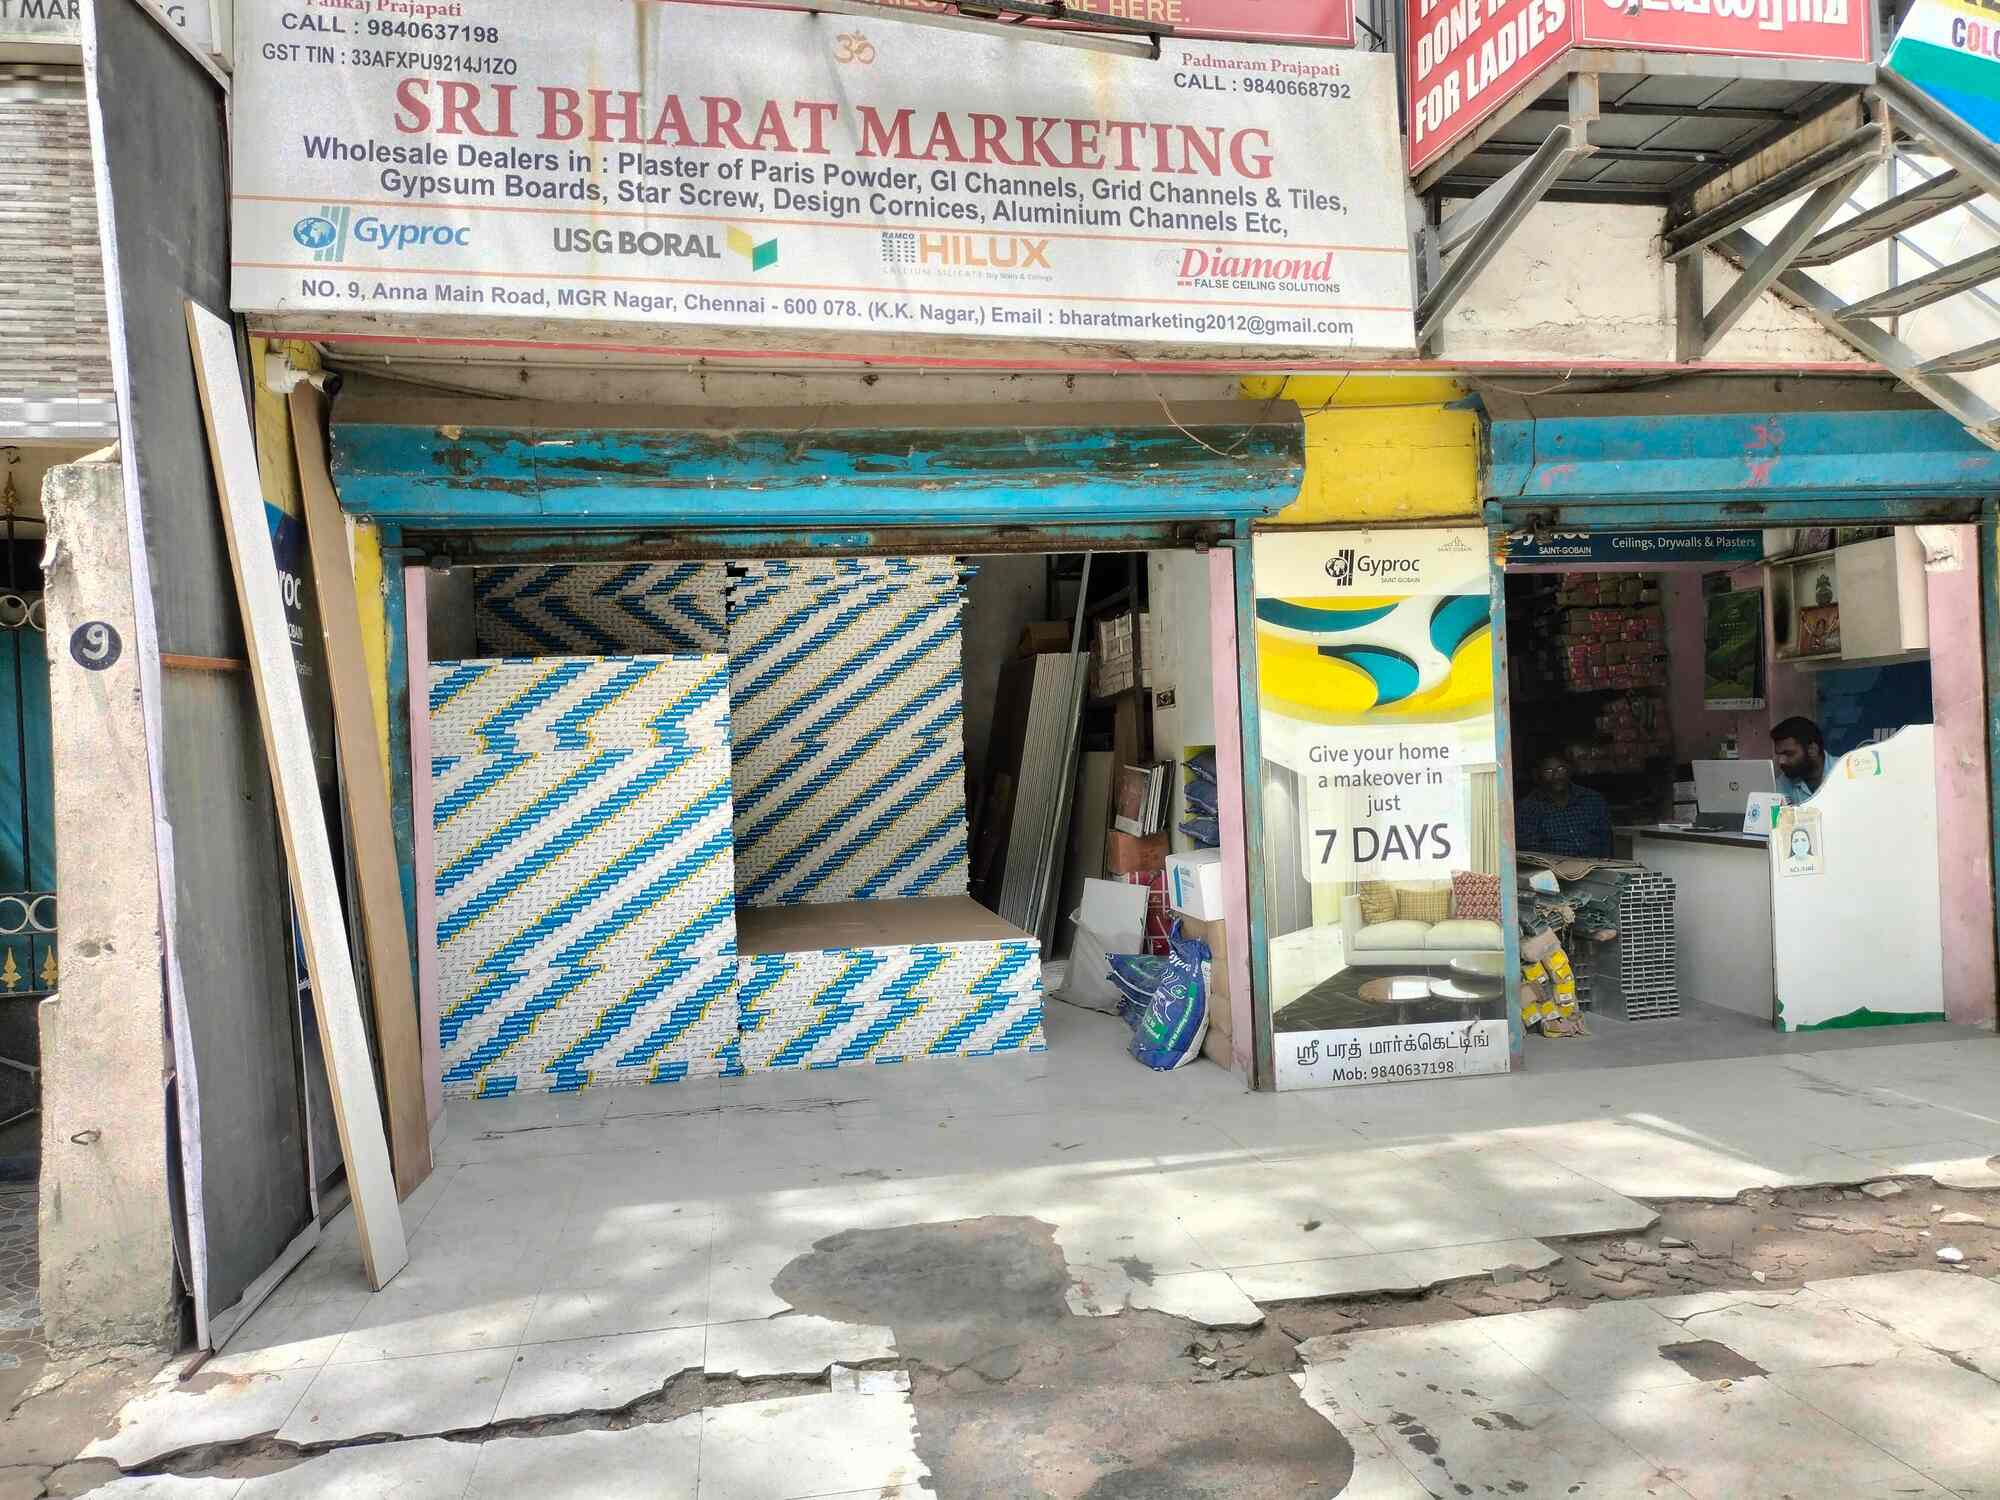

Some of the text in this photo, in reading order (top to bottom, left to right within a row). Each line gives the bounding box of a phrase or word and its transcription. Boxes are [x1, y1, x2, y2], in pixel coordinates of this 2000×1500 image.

[20, 0, 80, 19] MAR
[376, 0, 462, 18] Prajapati
[282, 13, 346, 33] CALL
[367, 19, 499, 43] 9840637198
[1417, 0, 1482, 81] DONE
[263, 43, 300, 62] GST
[305, 46, 334, 64] TIN
[1182, 53, 1341, 78] Padmaram Prajapati
[1174, 72, 1226, 91] CALL
[1243, 77, 1351, 98] 9840668792
[1416, 0, 1566, 144] FOR LADIES
[394, 78, 1275, 180] SRI BHARAT MARKETING
[303, 135, 448, 166] Wholesale
[458, 144, 559, 171] Dealers
[569, 150, 591, 173] in
[618, 152, 709, 178] Plaster
[718, 158, 743, 180] of
[751, 159, 814, 184] Paris
[824, 164, 922, 194] Powder,
[930, 169, 956, 192] GI
[964, 171, 1085, 202] Channels,
[1092, 177, 1141, 201] Grid
[1150, 180, 1257, 207] Channels
[1265, 187, 1281, 207] &
[1287, 188, 1348, 215] Tiles,
[380, 168, 1288, 237] Gypsum Boards, Star Screw, Design Cornices, Aluminium Channels Etc,
[354, 216, 471, 250] Gyproc
[553, 227, 720, 259] USG BORAL
[882, 232, 915, 240] RAMCO
[920, 233, 1051, 268] HILUX
[1177, 247, 1334, 282] Diamond
[1194, 279, 1340, 294] FALSE CEILING SOLUTIONS
[302, 279, 341, 298] NO.
[348, 281, 365, 301] 9,
[373, 282, 427, 301] Anna
[435, 284, 483, 303] Main
[492, 287, 550, 307] Road,
[558, 289, 607, 307] MGR
[614, 291, 678, 312] Nagar,
[684, 294, 765, 313] Chennai
[784, 298, 817, 316] 600
[823, 299, 861, 318] 078.
[868, 300, 914, 322] (K.K.
[920, 304, 985, 326] Nagar,)
[991, 307, 1042, 325] Email
[1059, 309, 1354, 335] bharatmarketing2012@gmail.com
[1539, 546, 1592, 555] SAINT-GOBAIN
[1612, 537, 1756, 550] Ceilings, Drywalls & Plasters
[1357, 555, 1420, 577] Gyproc
[81, 624, 109, 661] 9
[1309, 742, 1449, 769] Give your home
[1318, 768, 1443, 788] a makeover in
[1366, 794, 1401, 817] just
[1315, 823, 1452, 864] 7 DAYS
[1326, 1038, 1361, 1061] பரத்
[1332, 1061, 1454, 1082] Mob: 9840637198
